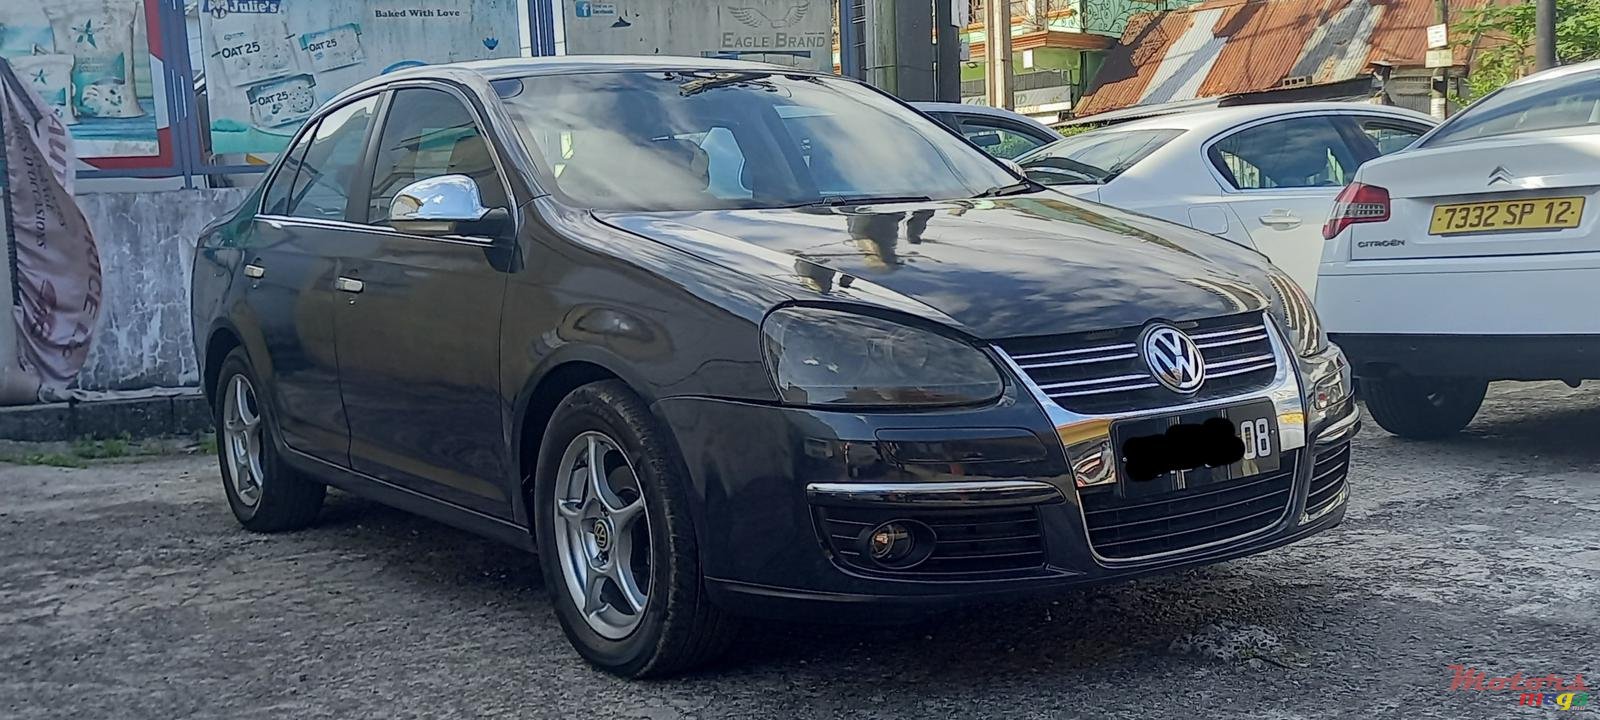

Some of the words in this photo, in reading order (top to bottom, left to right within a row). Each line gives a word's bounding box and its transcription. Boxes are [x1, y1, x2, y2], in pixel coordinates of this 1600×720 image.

[230, 0, 279, 13] Julie's
[375, 9, 406, 18] Baked
[409, 9, 434, 18] With
[437, 9, 460, 18] Love
[309, 41, 325, 52] OAT
[325, 38, 337, 49] 25
[722, 32, 770, 48] EAGLE
[774, 32, 826, 48] BRAND
[221, 45, 244, 58] OAT
[244, 41, 261, 54] 25
[258, 94, 276, 106] OAT
[275, 91, 289, 102] 25
[1443, 205, 1499, 230] 7332
[1503, 203, 1535, 226] SP
[1544, 201, 1572, 224] 12
[1240, 418, 1272, 461] 08
